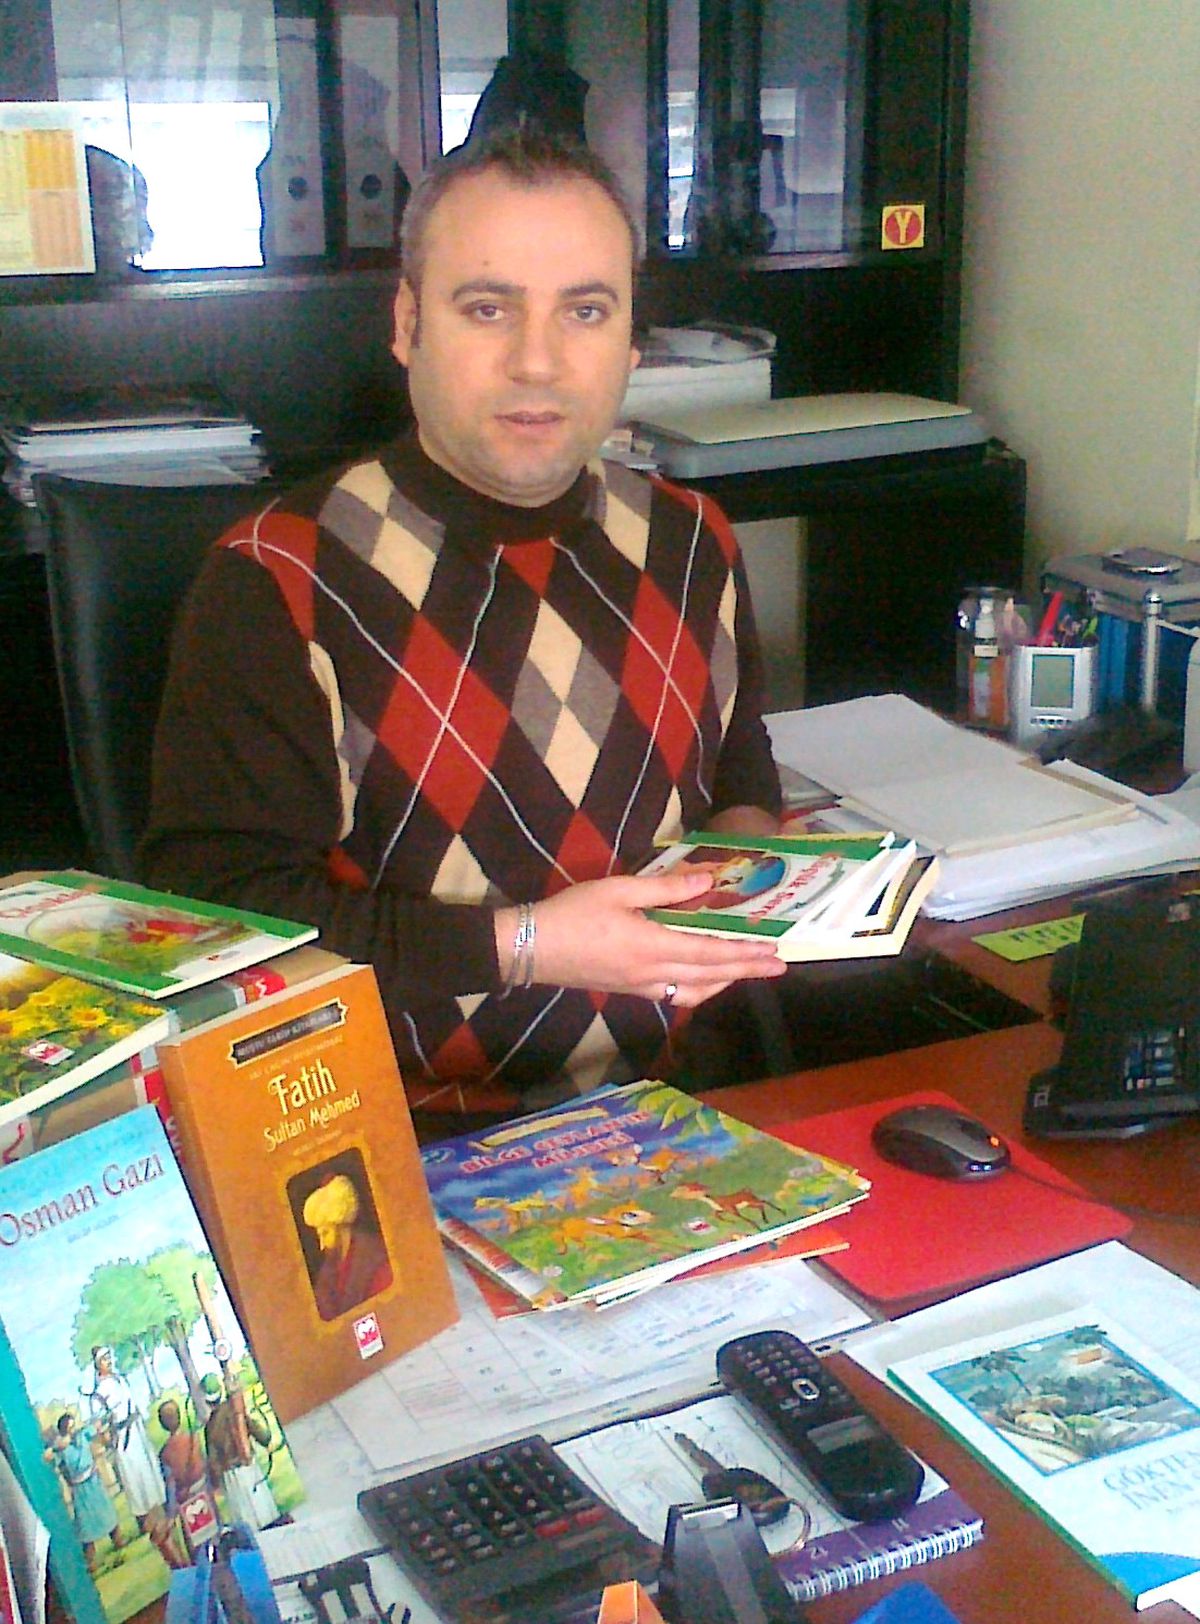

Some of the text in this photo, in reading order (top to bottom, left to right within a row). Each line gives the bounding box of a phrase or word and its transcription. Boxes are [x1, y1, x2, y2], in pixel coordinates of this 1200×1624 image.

[267, 1057, 337, 1116] Fatih
[263, 1118, 306, 1153] Sultan
[308, 1088, 361, 1129] Mehmed
[0, 1184, 100, 1246] Osman
[102, 1149, 166, 1196] Gazi
